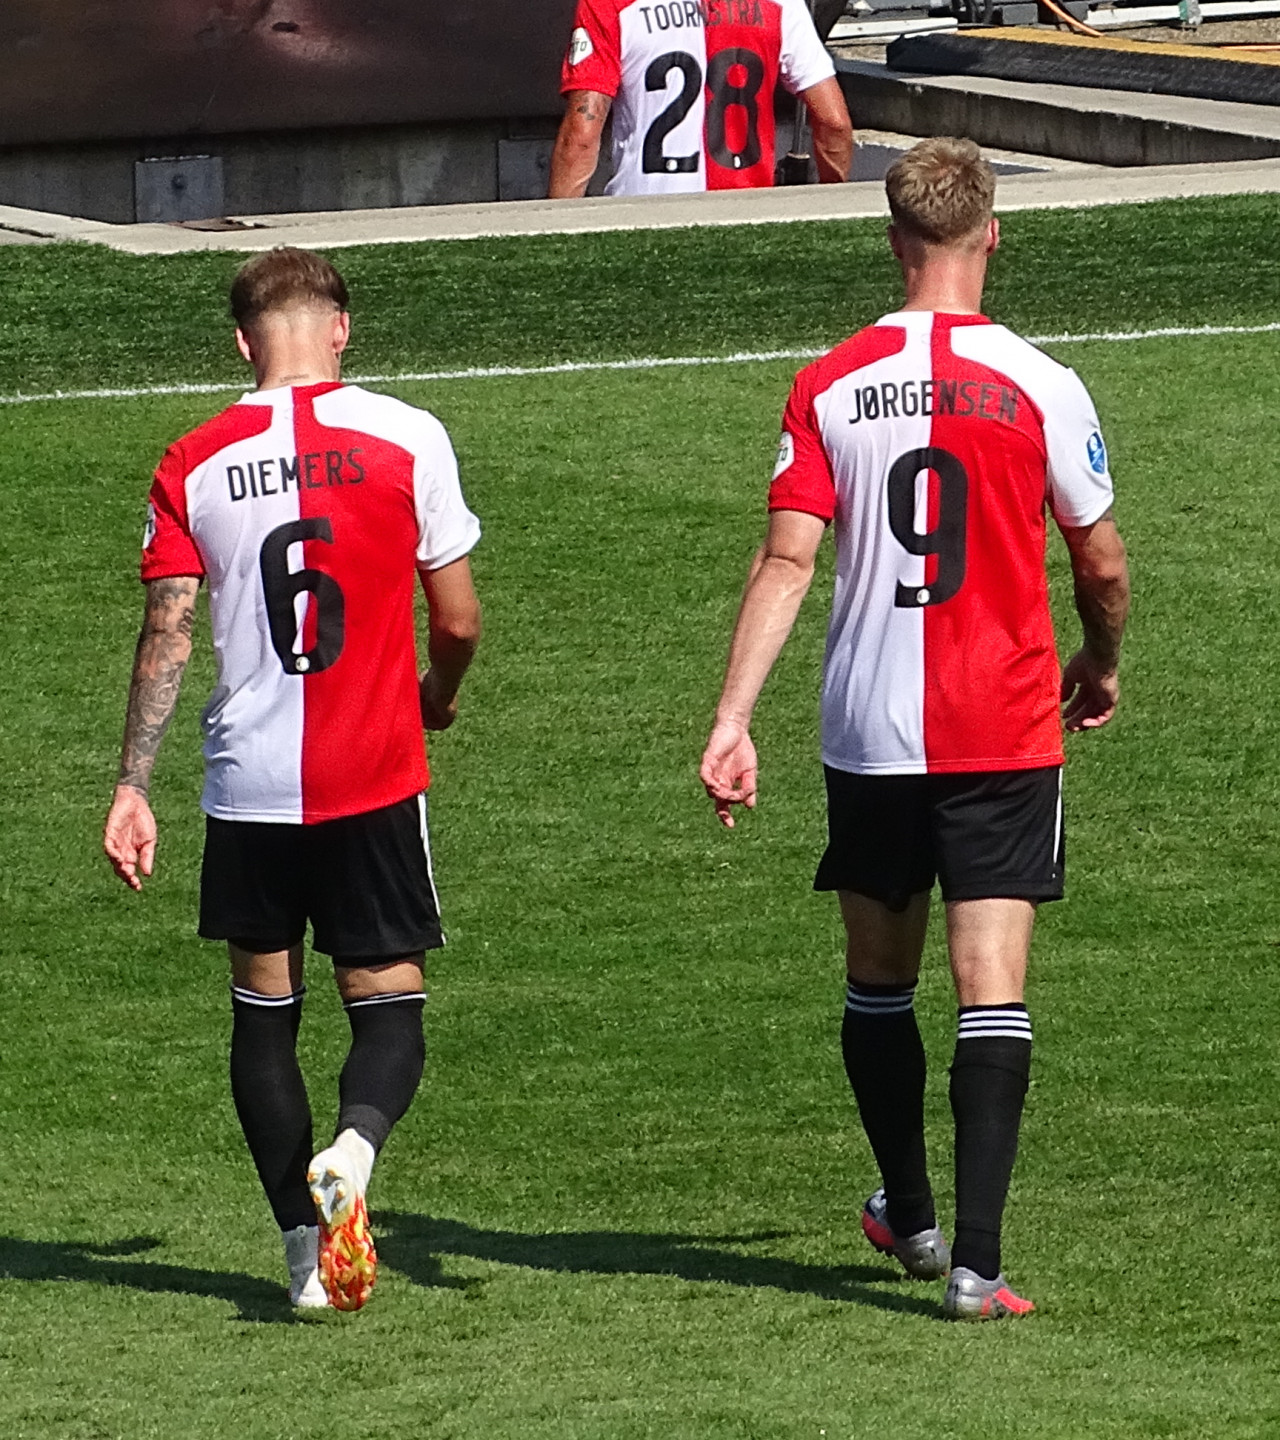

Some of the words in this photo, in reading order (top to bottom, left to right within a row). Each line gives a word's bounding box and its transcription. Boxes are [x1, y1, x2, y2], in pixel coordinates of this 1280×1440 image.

[642, 48, 765, 174] 28
[848, 380, 1019, 425] JØRGENSEN
[226, 448, 366, 502] DIEMERS
[887, 447, 969, 609] 9
[260, 517, 346, 675] 6
